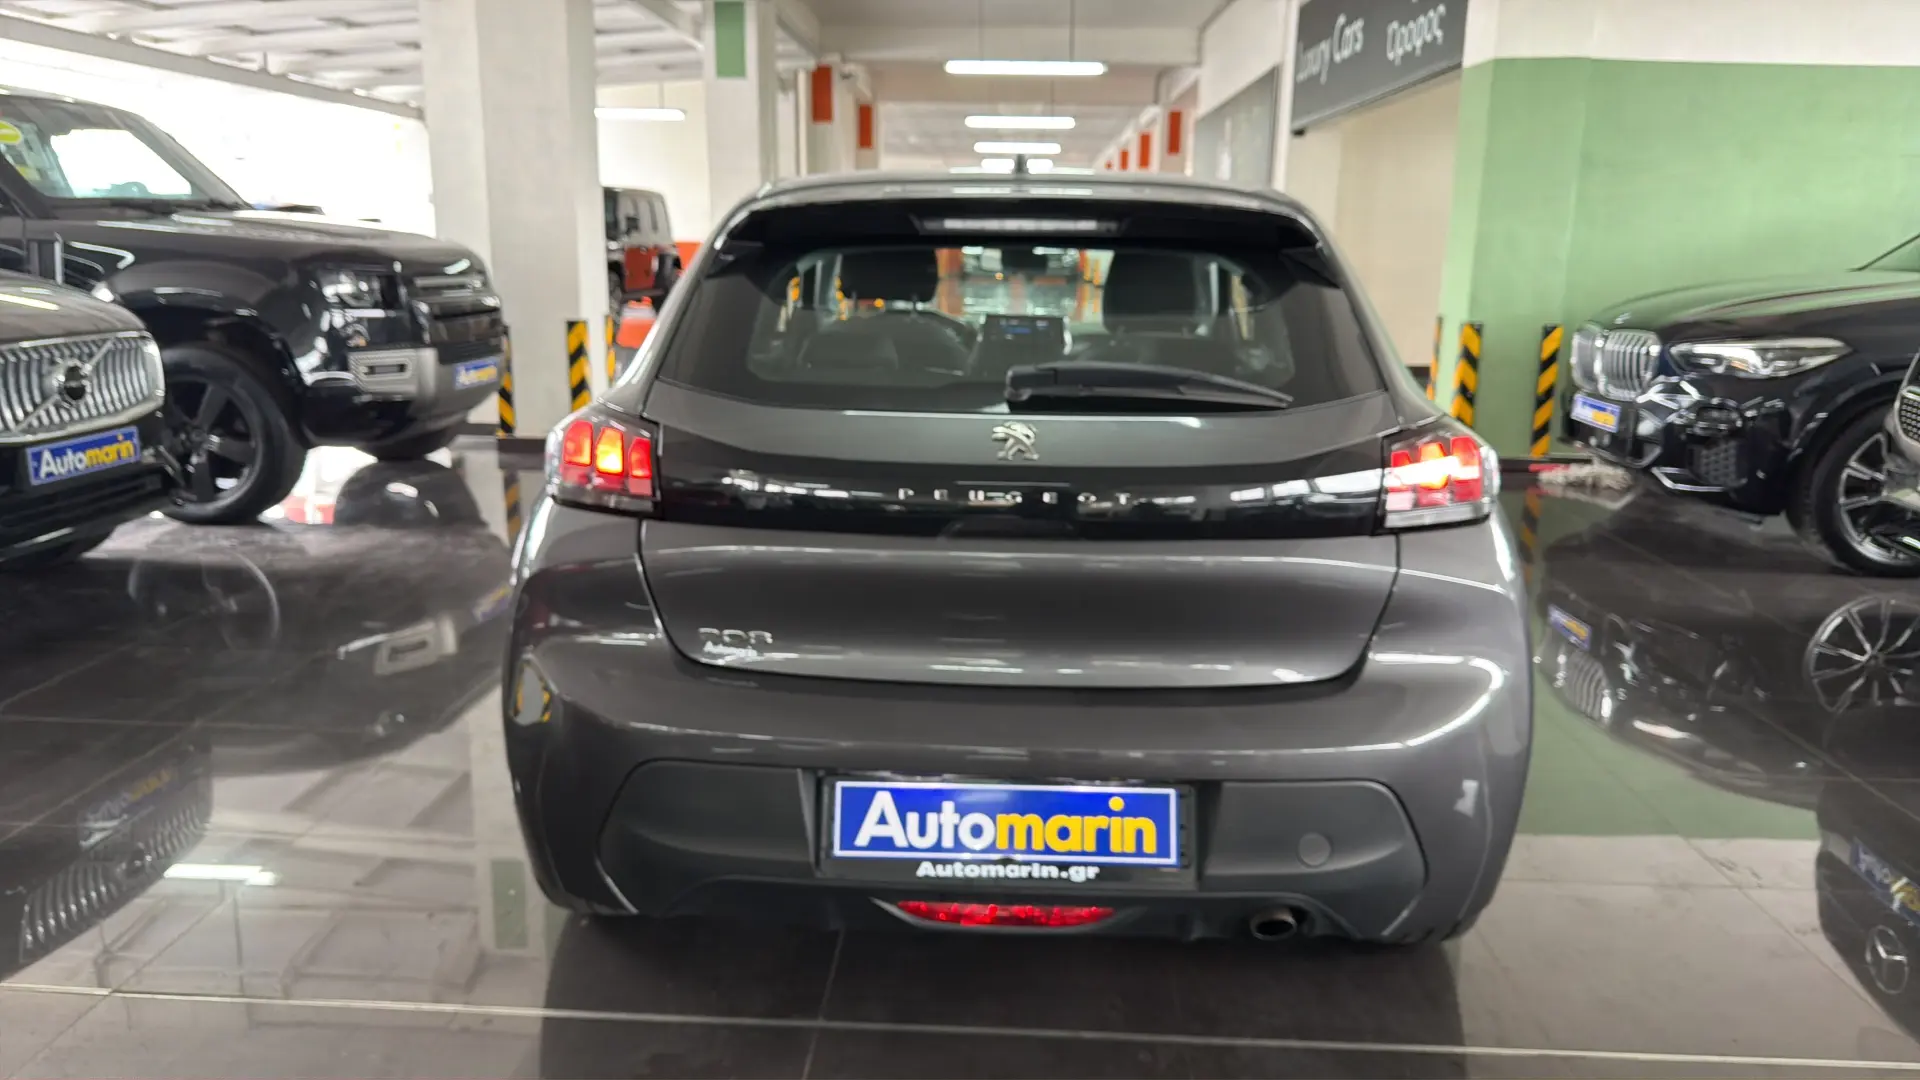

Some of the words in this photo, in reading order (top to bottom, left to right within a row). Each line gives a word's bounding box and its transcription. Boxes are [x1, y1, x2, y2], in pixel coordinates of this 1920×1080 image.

[1333, 12, 1365, 64] Cars
[39, 433, 135, 479] Automarin
[898, 487, 1131, 506] PEUGEOT
[853, 790, 1158, 854] Automarin
[915, 860, 1101, 882] Automarin.gr
